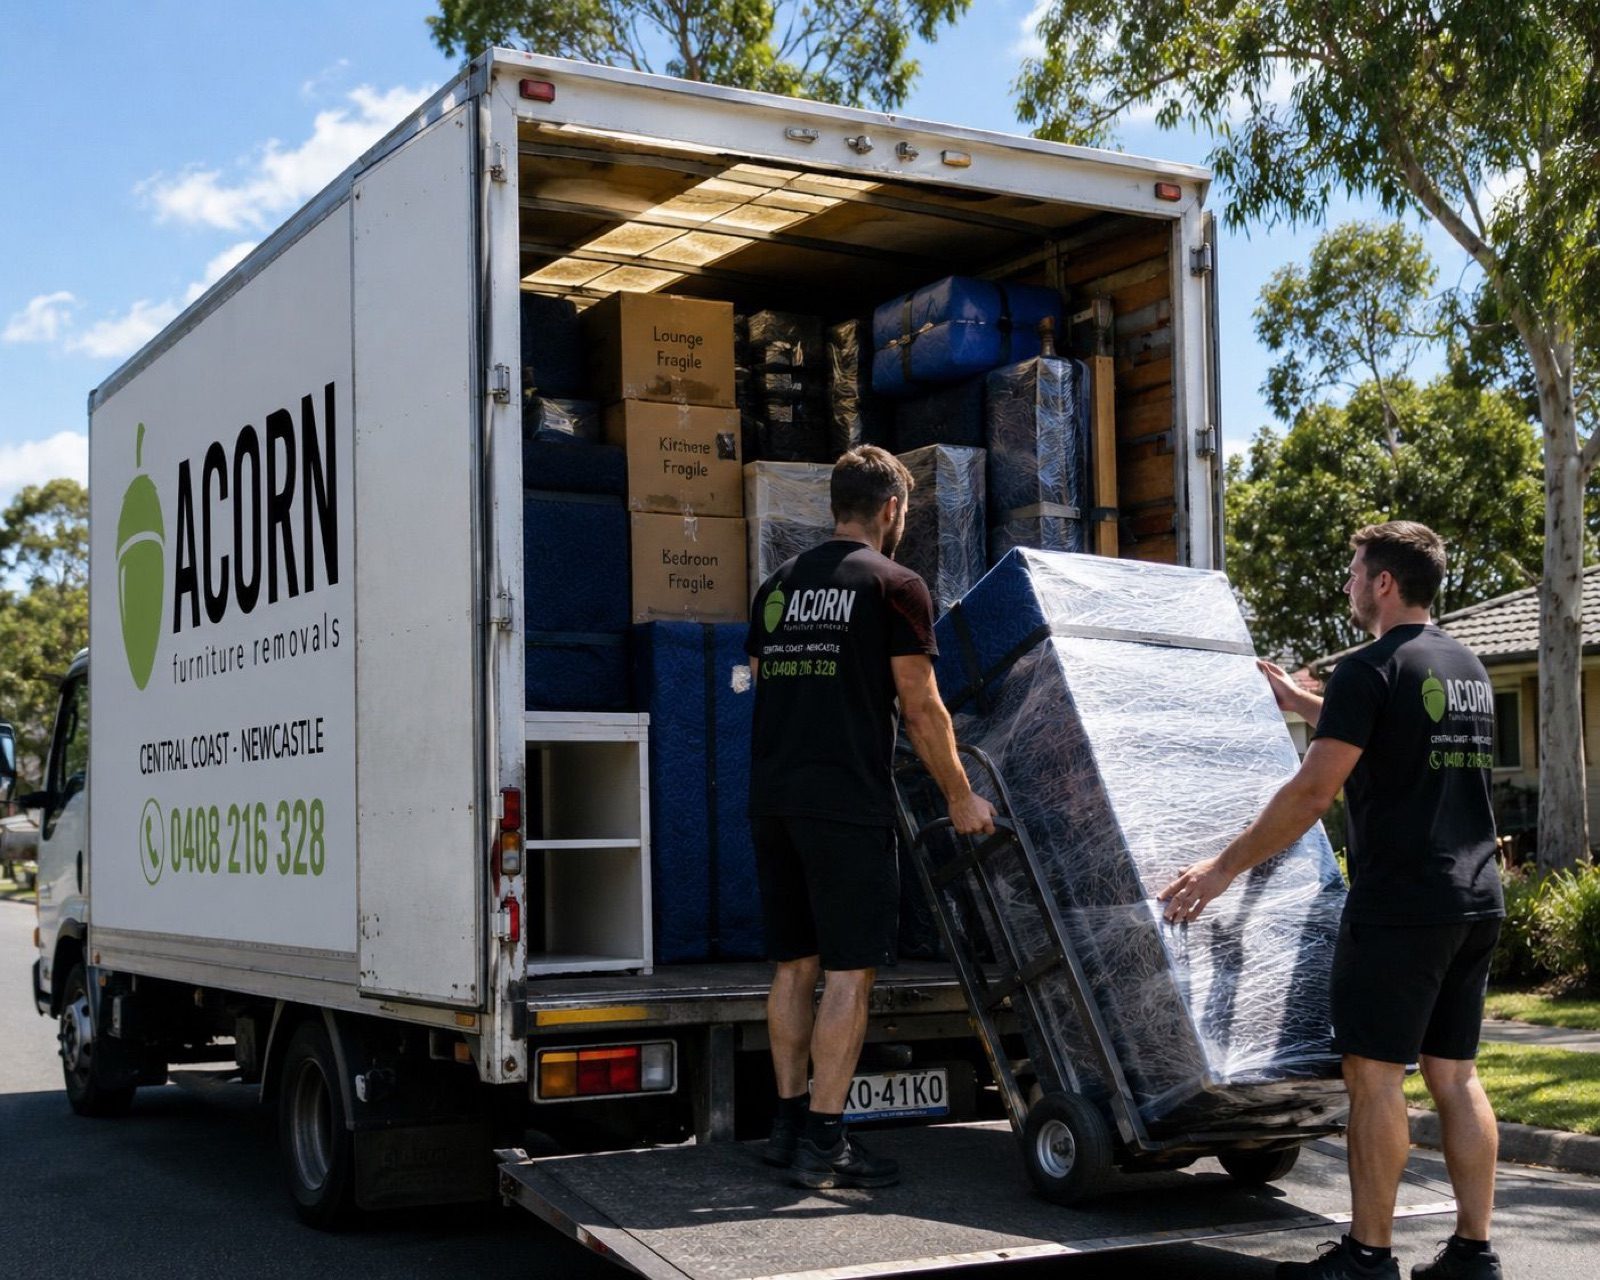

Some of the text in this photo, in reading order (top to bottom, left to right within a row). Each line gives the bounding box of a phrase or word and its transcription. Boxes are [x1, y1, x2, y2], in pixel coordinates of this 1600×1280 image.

[653, 325, 704, 350] Lounge
[657, 350, 703, 373] Fragile
[173, 381, 340, 633] ACORN
[668, 573, 715, 594] Fragile
[785, 588, 857, 623] ACORN
[172, 612, 340, 685] furniture removals
[772, 660, 797, 677] 0408
[814, 660, 838, 677] 328
[1446, 679, 1495, 715] ACORN
[139, 739, 188, 775] CENTRAL
[191, 731, 230, 769] COAST
[242, 717, 324, 763] NEWCASTLE
[170, 798, 325, 877] 0408 216 328
